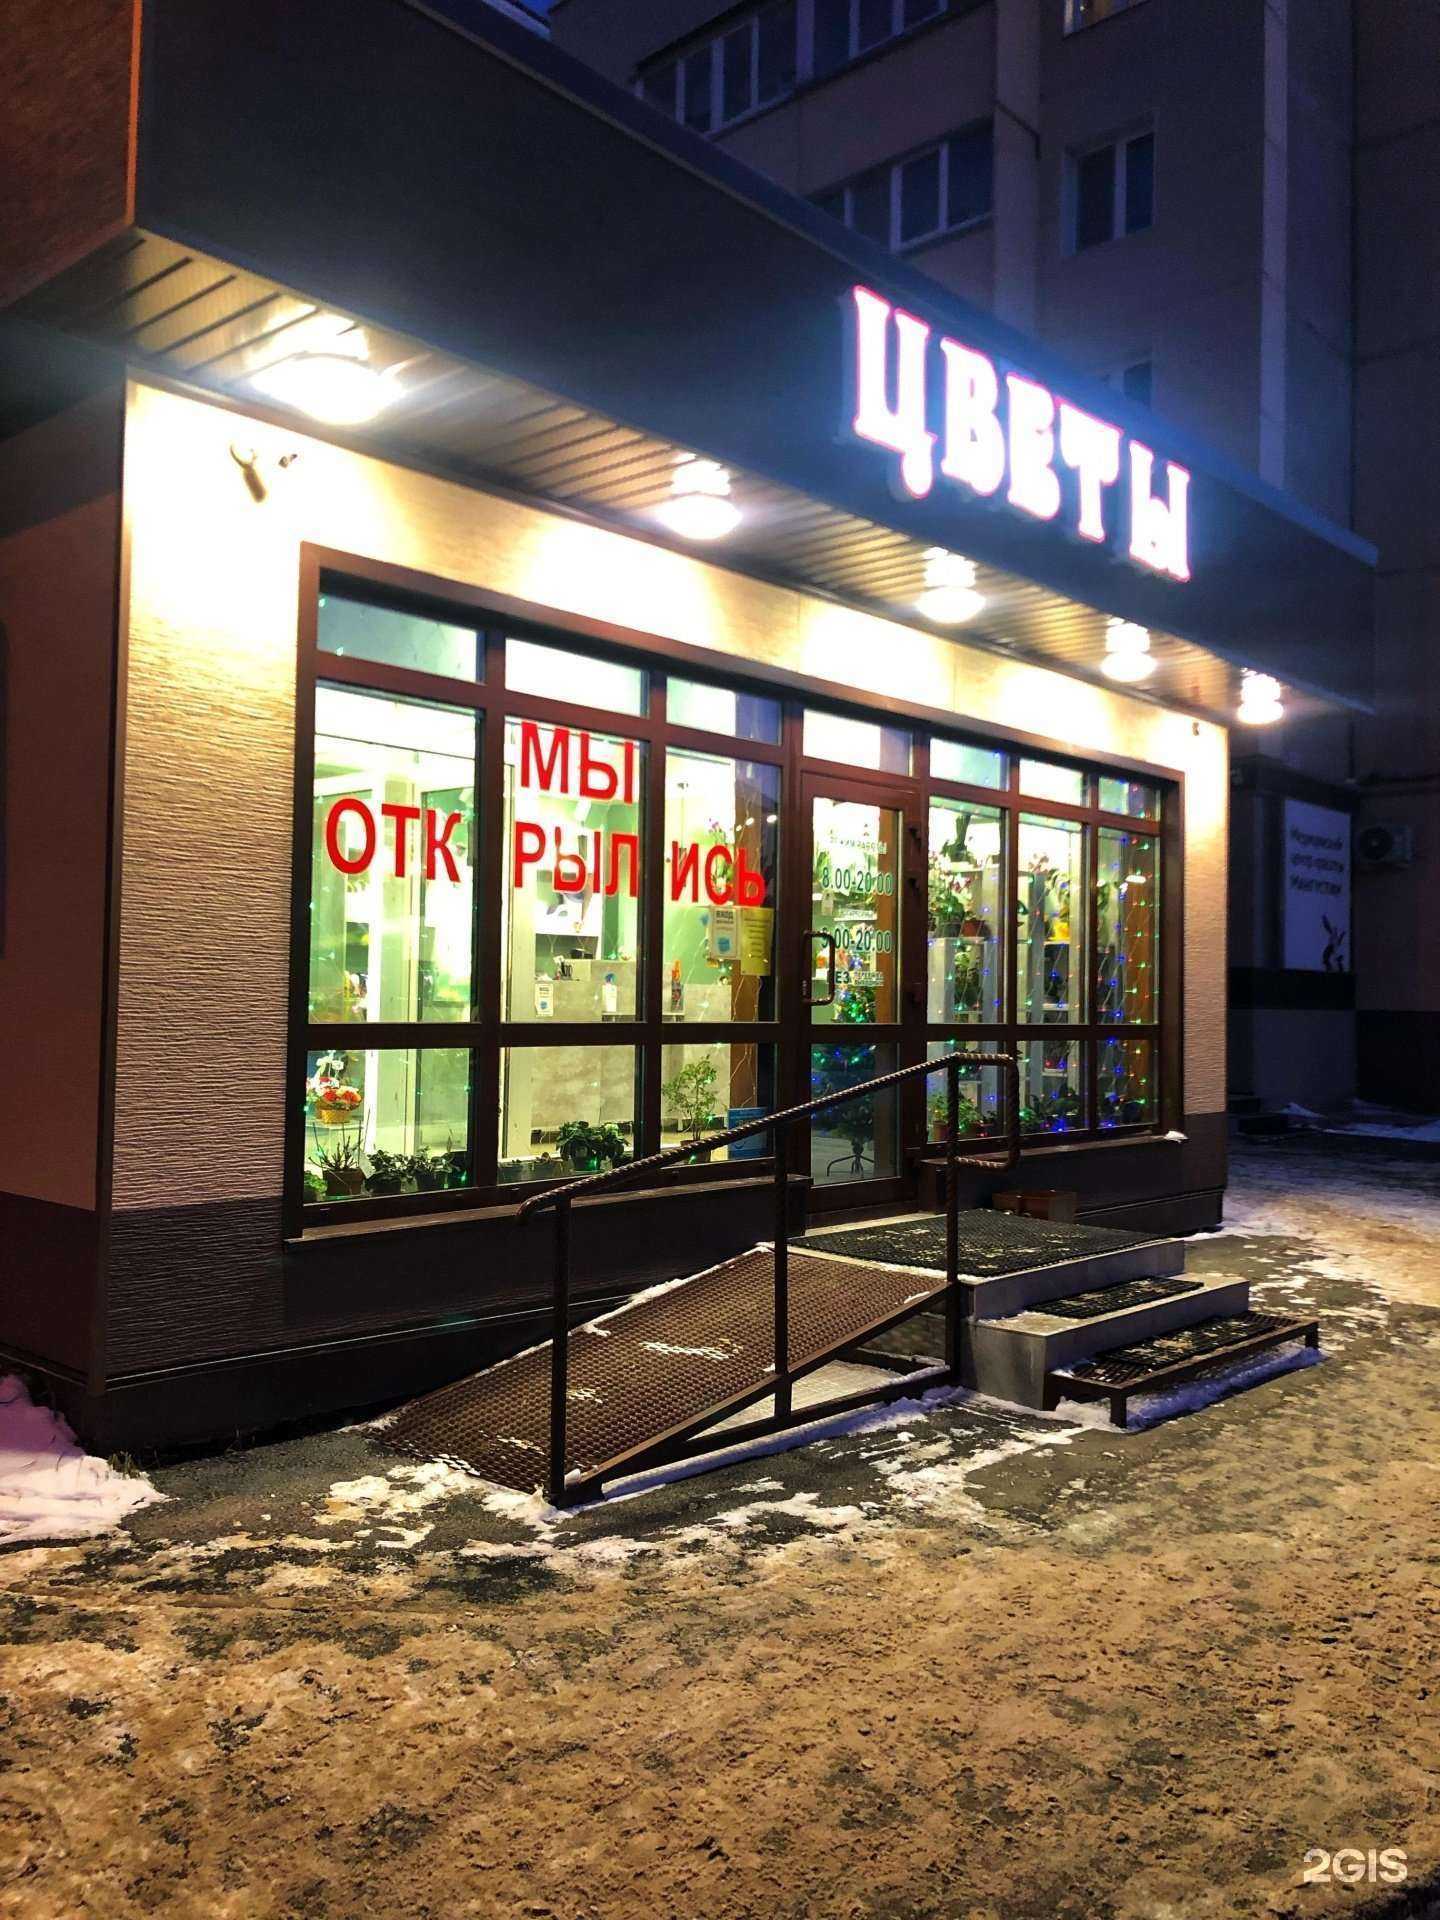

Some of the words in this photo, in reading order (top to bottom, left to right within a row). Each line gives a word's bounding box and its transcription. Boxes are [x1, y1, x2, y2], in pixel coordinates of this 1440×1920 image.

[854, 285, 1191, 582] ЦВЕТЫ
[519, 720, 635, 804] МЫ
[821, 928, 892, 953] 900-20.00
